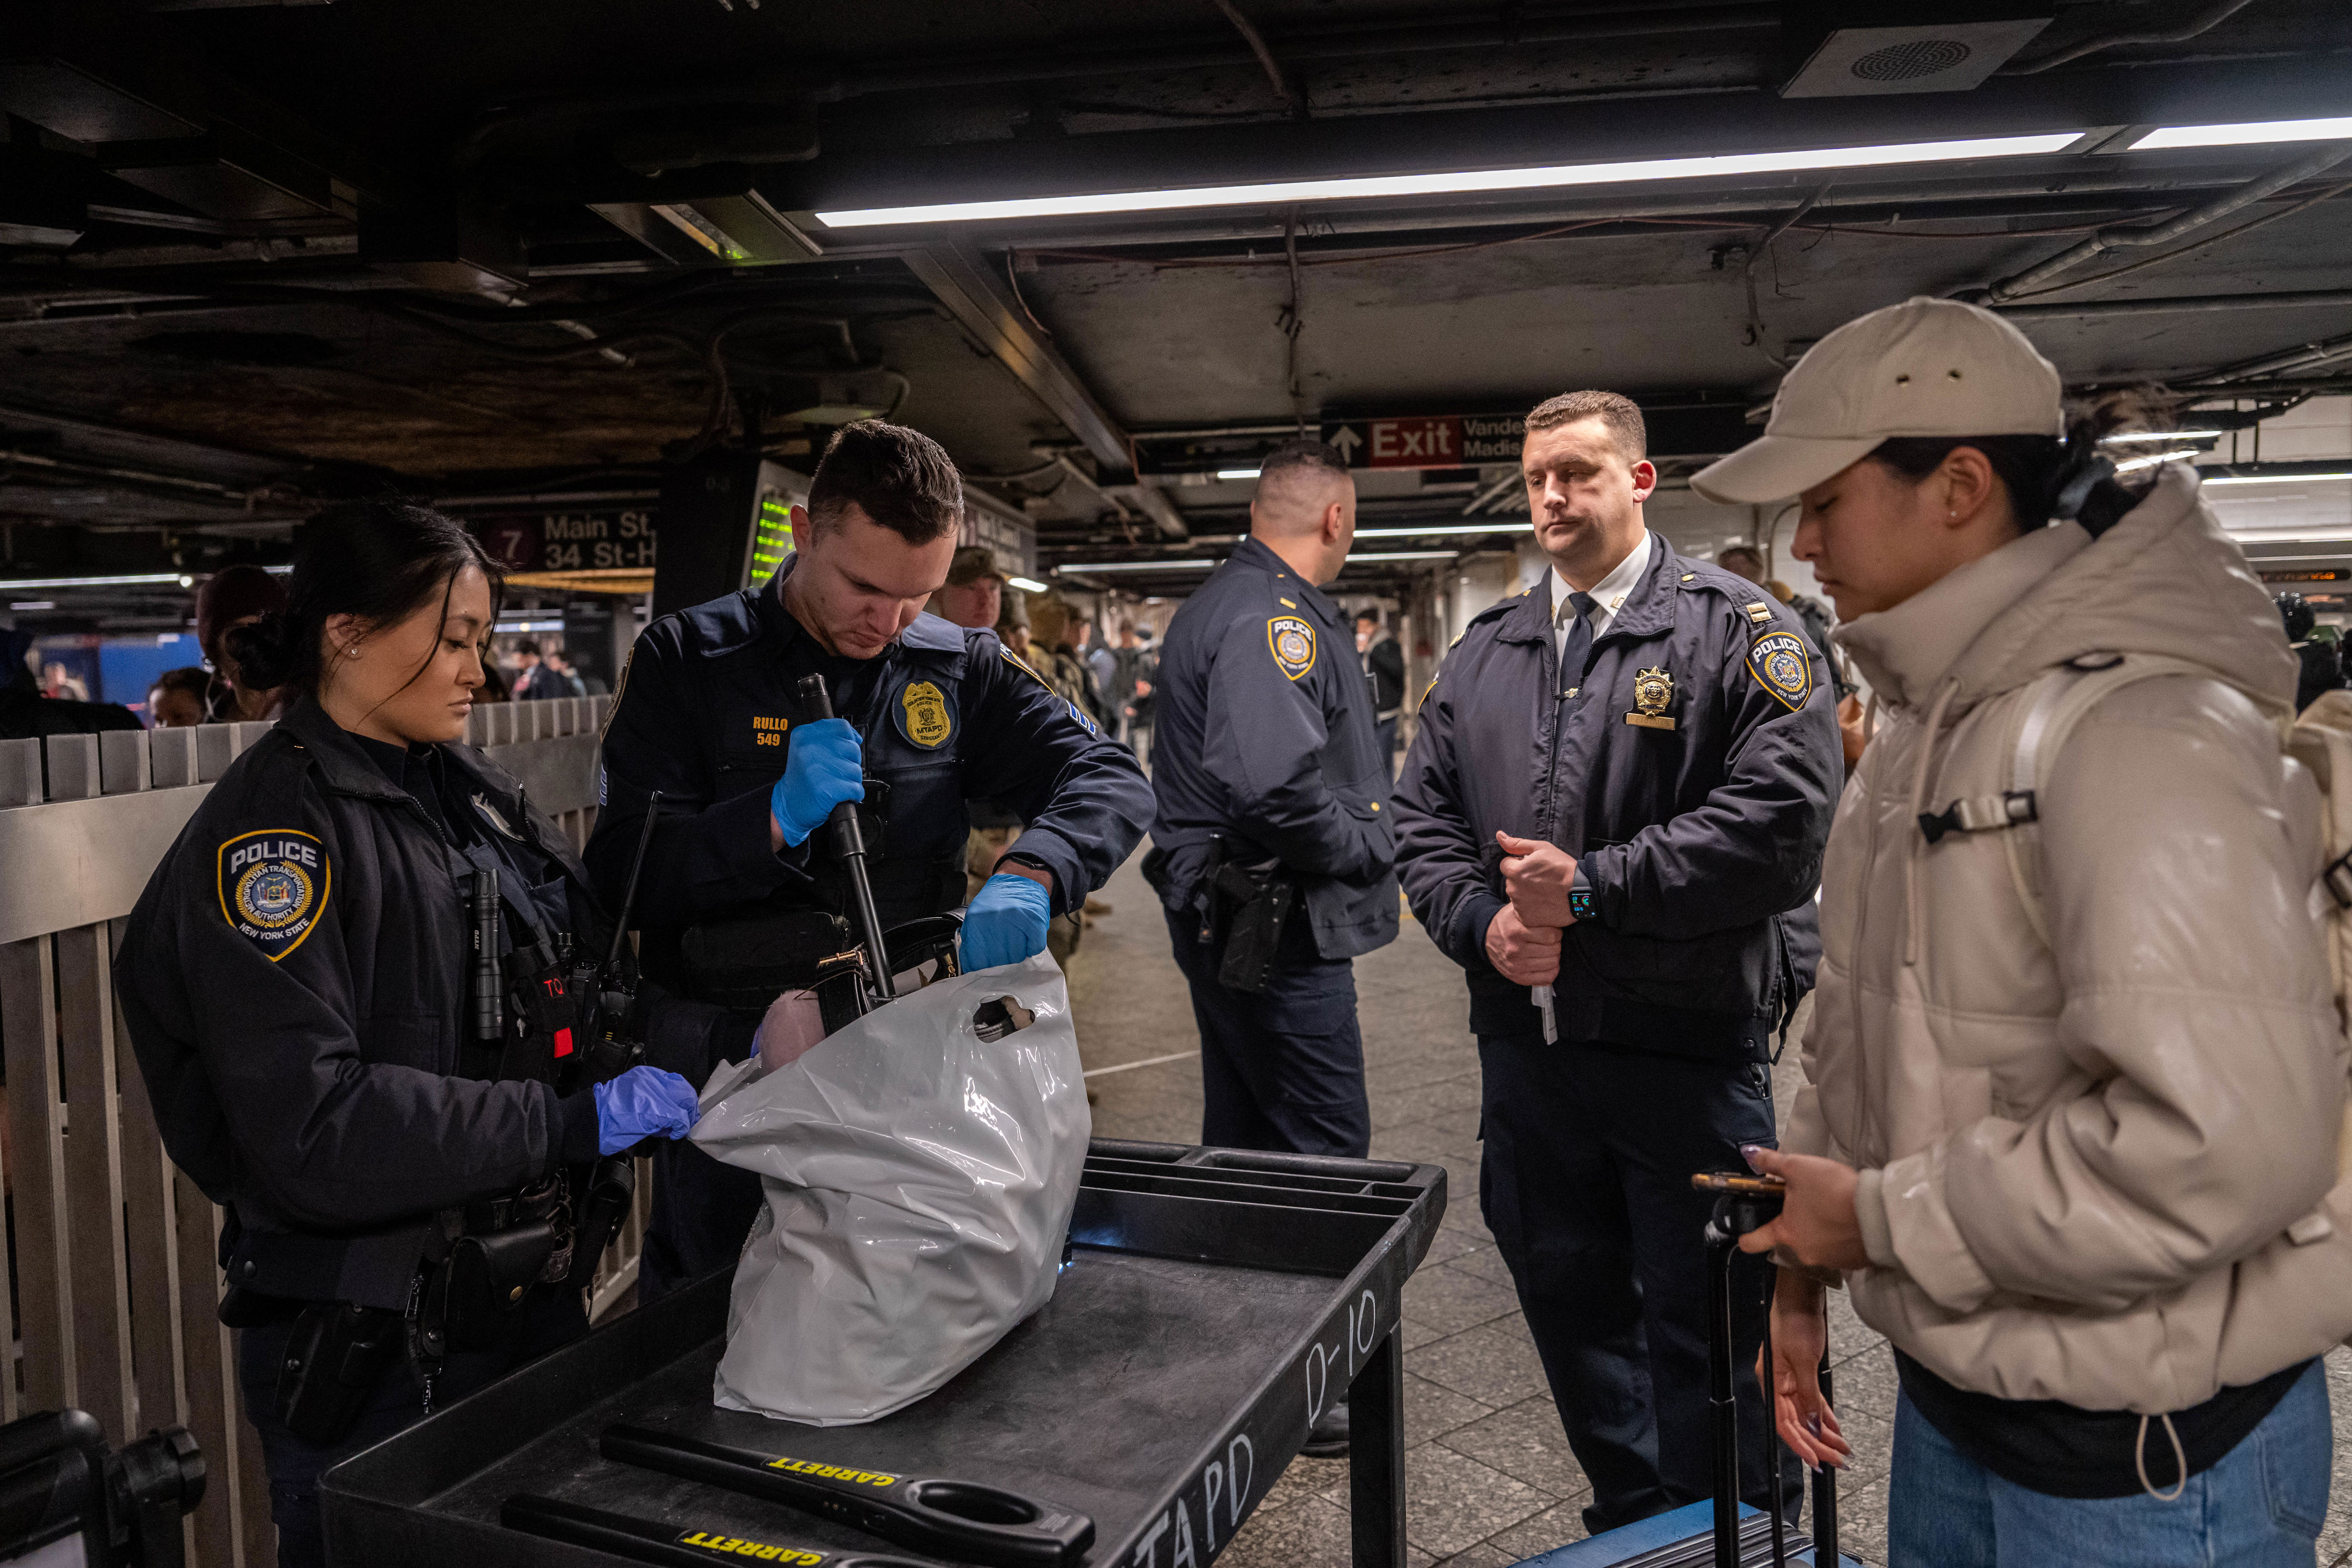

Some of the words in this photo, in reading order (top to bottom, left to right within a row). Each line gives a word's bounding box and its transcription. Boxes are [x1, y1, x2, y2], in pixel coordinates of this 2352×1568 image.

[1463, 418, 1523, 436] Vande
[1373, 422, 1452, 457] Exit
[1463, 440, 1522, 457] Madis
[545, 514, 608, 540] Main
[502, 530, 522, 560] 7
[545, 542, 580, 569] 34
[1274, 620, 1312, 641] POLICE
[1752, 637, 1803, 664] POLICE
[1776, 688, 1788, 698] NEW
[1798, 687, 1808, 700] STATE
[1782, 678, 1801, 688] AUTHORITY
[753, 716, 788, 731] RULLO
[916, 725, 942, 734] MTAPD
[757, 732, 781, 747] 549
[231, 840, 318, 874] POLICE
[243, 867, 268, 913] METROPOLITAN
[268, 865, 305, 909] TRANSPORTATION
[253, 906, 294, 921] AUTHORITY
[238, 922, 259, 938] NEW
[259, 931, 285, 940] YORK
[285, 918, 310, 937] STATE
[543, 977, 564, 997] TQ
[1121, 1433, 1253, 1568] TAPD
[1306, 1289, 1376, 1430] D-10
[768, 1457, 895, 1486] GARRETT
[683, 1532, 821, 1566] GARRETT
